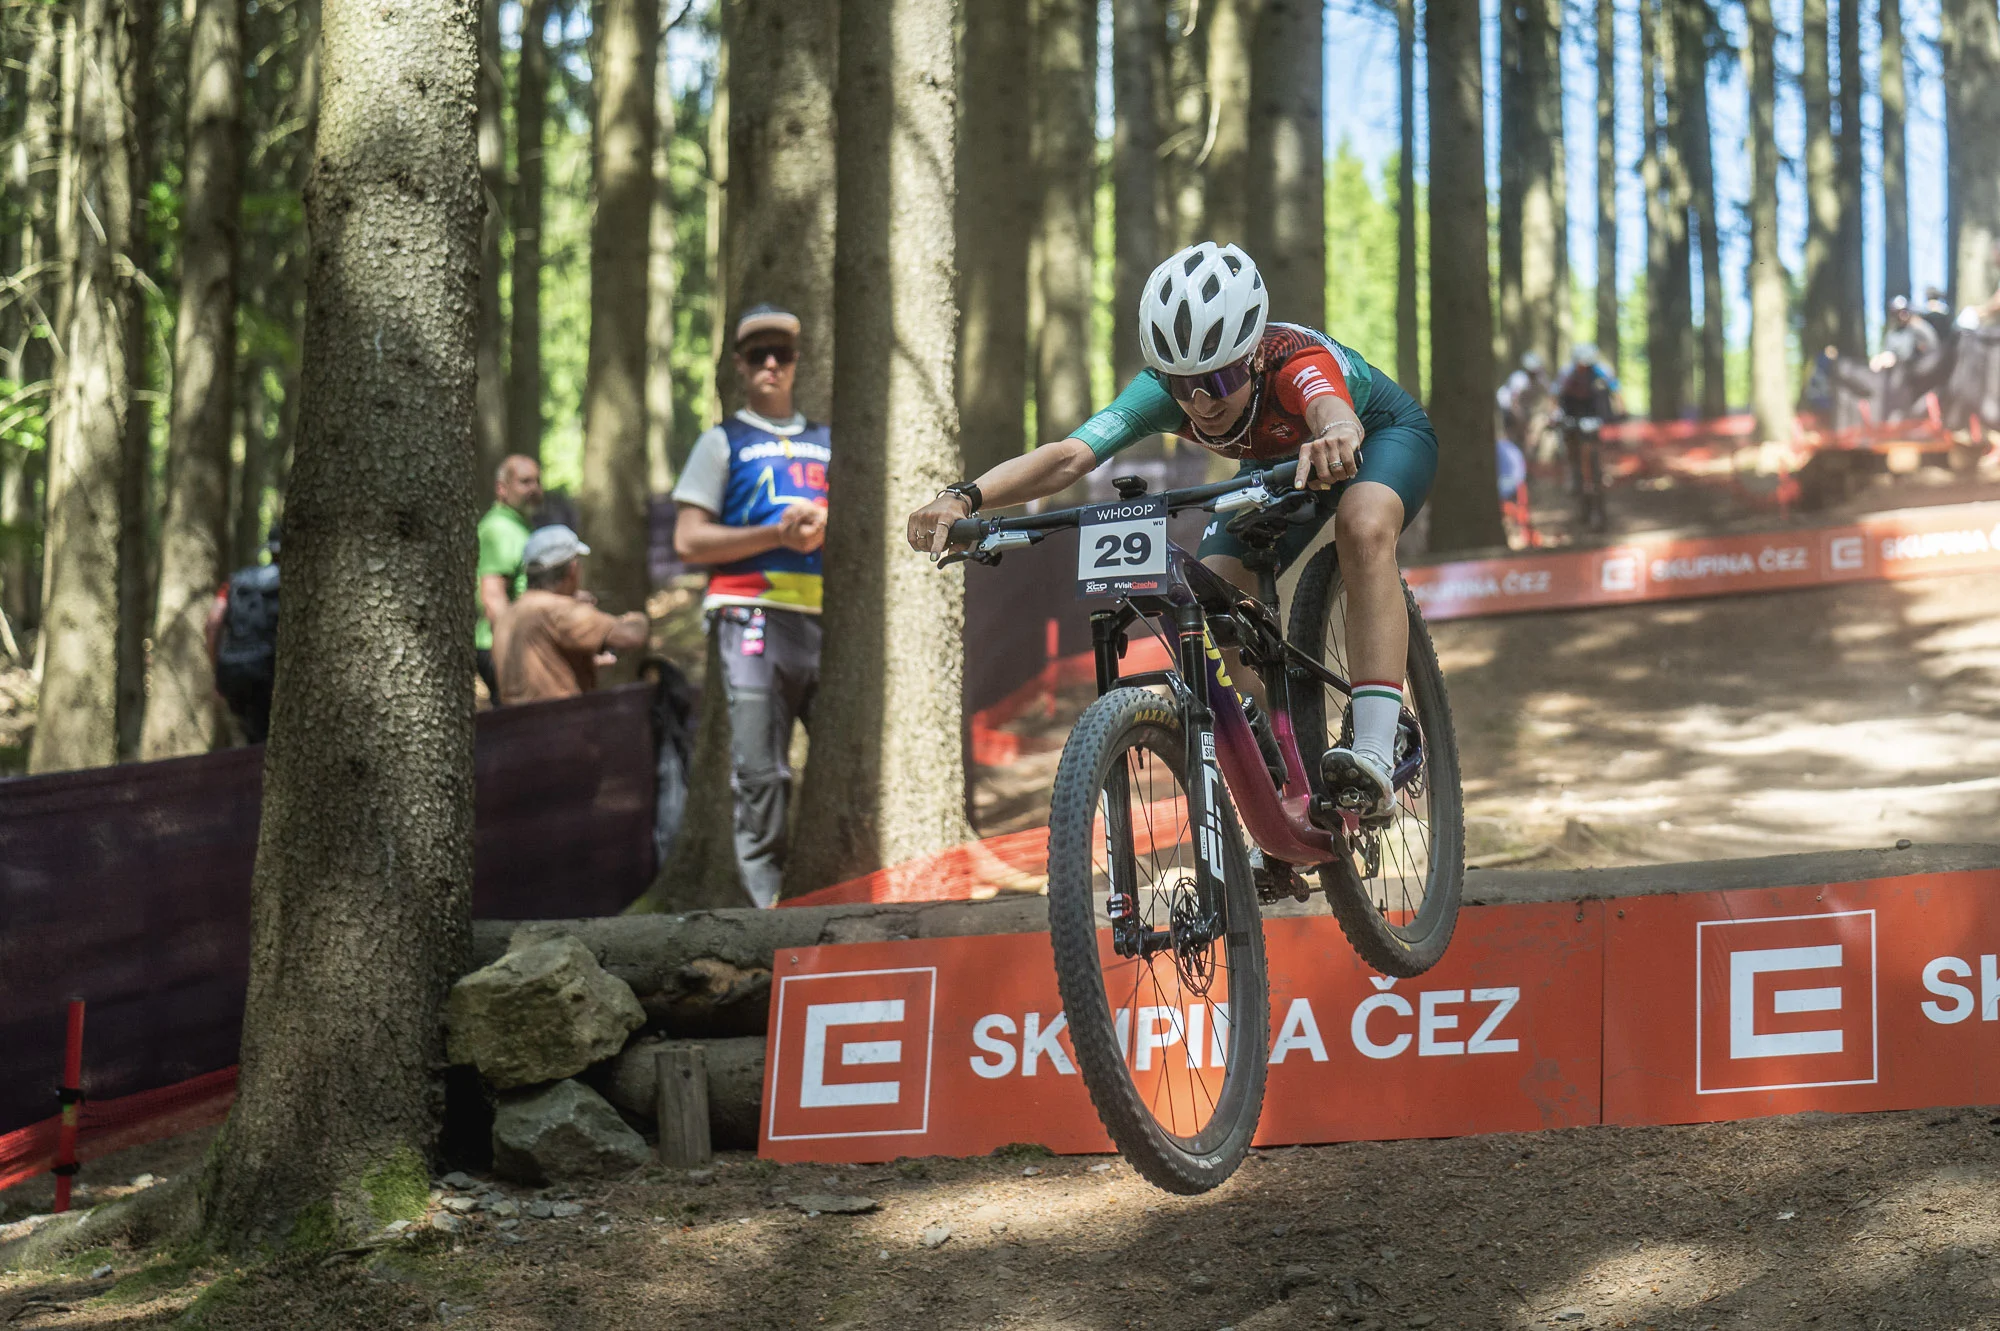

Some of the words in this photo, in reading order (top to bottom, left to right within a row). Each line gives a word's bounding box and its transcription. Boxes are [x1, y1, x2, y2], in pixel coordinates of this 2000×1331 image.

[1097, 504, 1155, 520] WHOOP
[1094, 532, 1151, 568] 29
[1650, 551, 1756, 582] SKUPINA
[1350, 975, 1520, 1060] ČEZ
